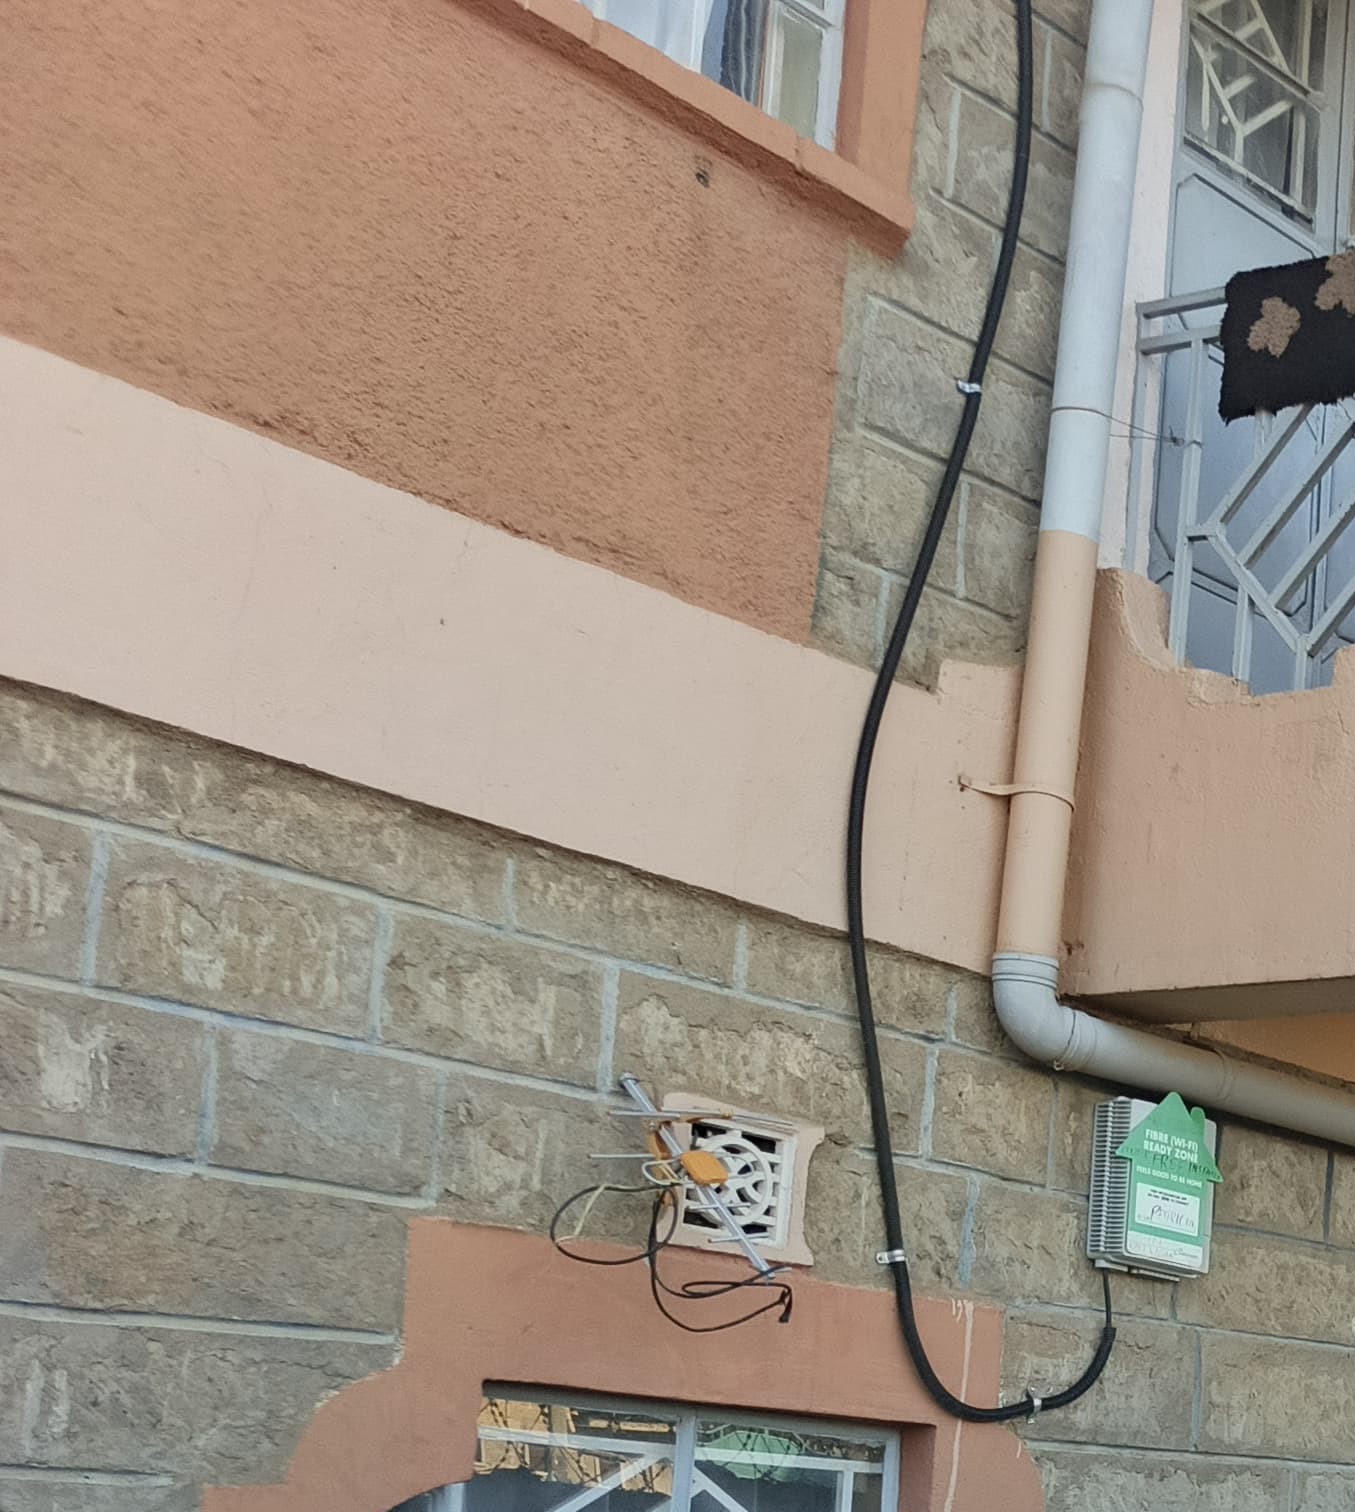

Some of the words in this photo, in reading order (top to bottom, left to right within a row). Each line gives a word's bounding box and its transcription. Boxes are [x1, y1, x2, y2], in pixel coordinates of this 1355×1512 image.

[1145, 1129, 1168, 1144] FIBRE
[1143, 1140, 1173, 1156] READY
[1174, 1148, 1199, 1163] ZONE
[1151, 1169, 1170, 1180] GOOD
[1170, 1174, 1178, 1182] TO
[1179, 1176, 1186, 1184] BE
